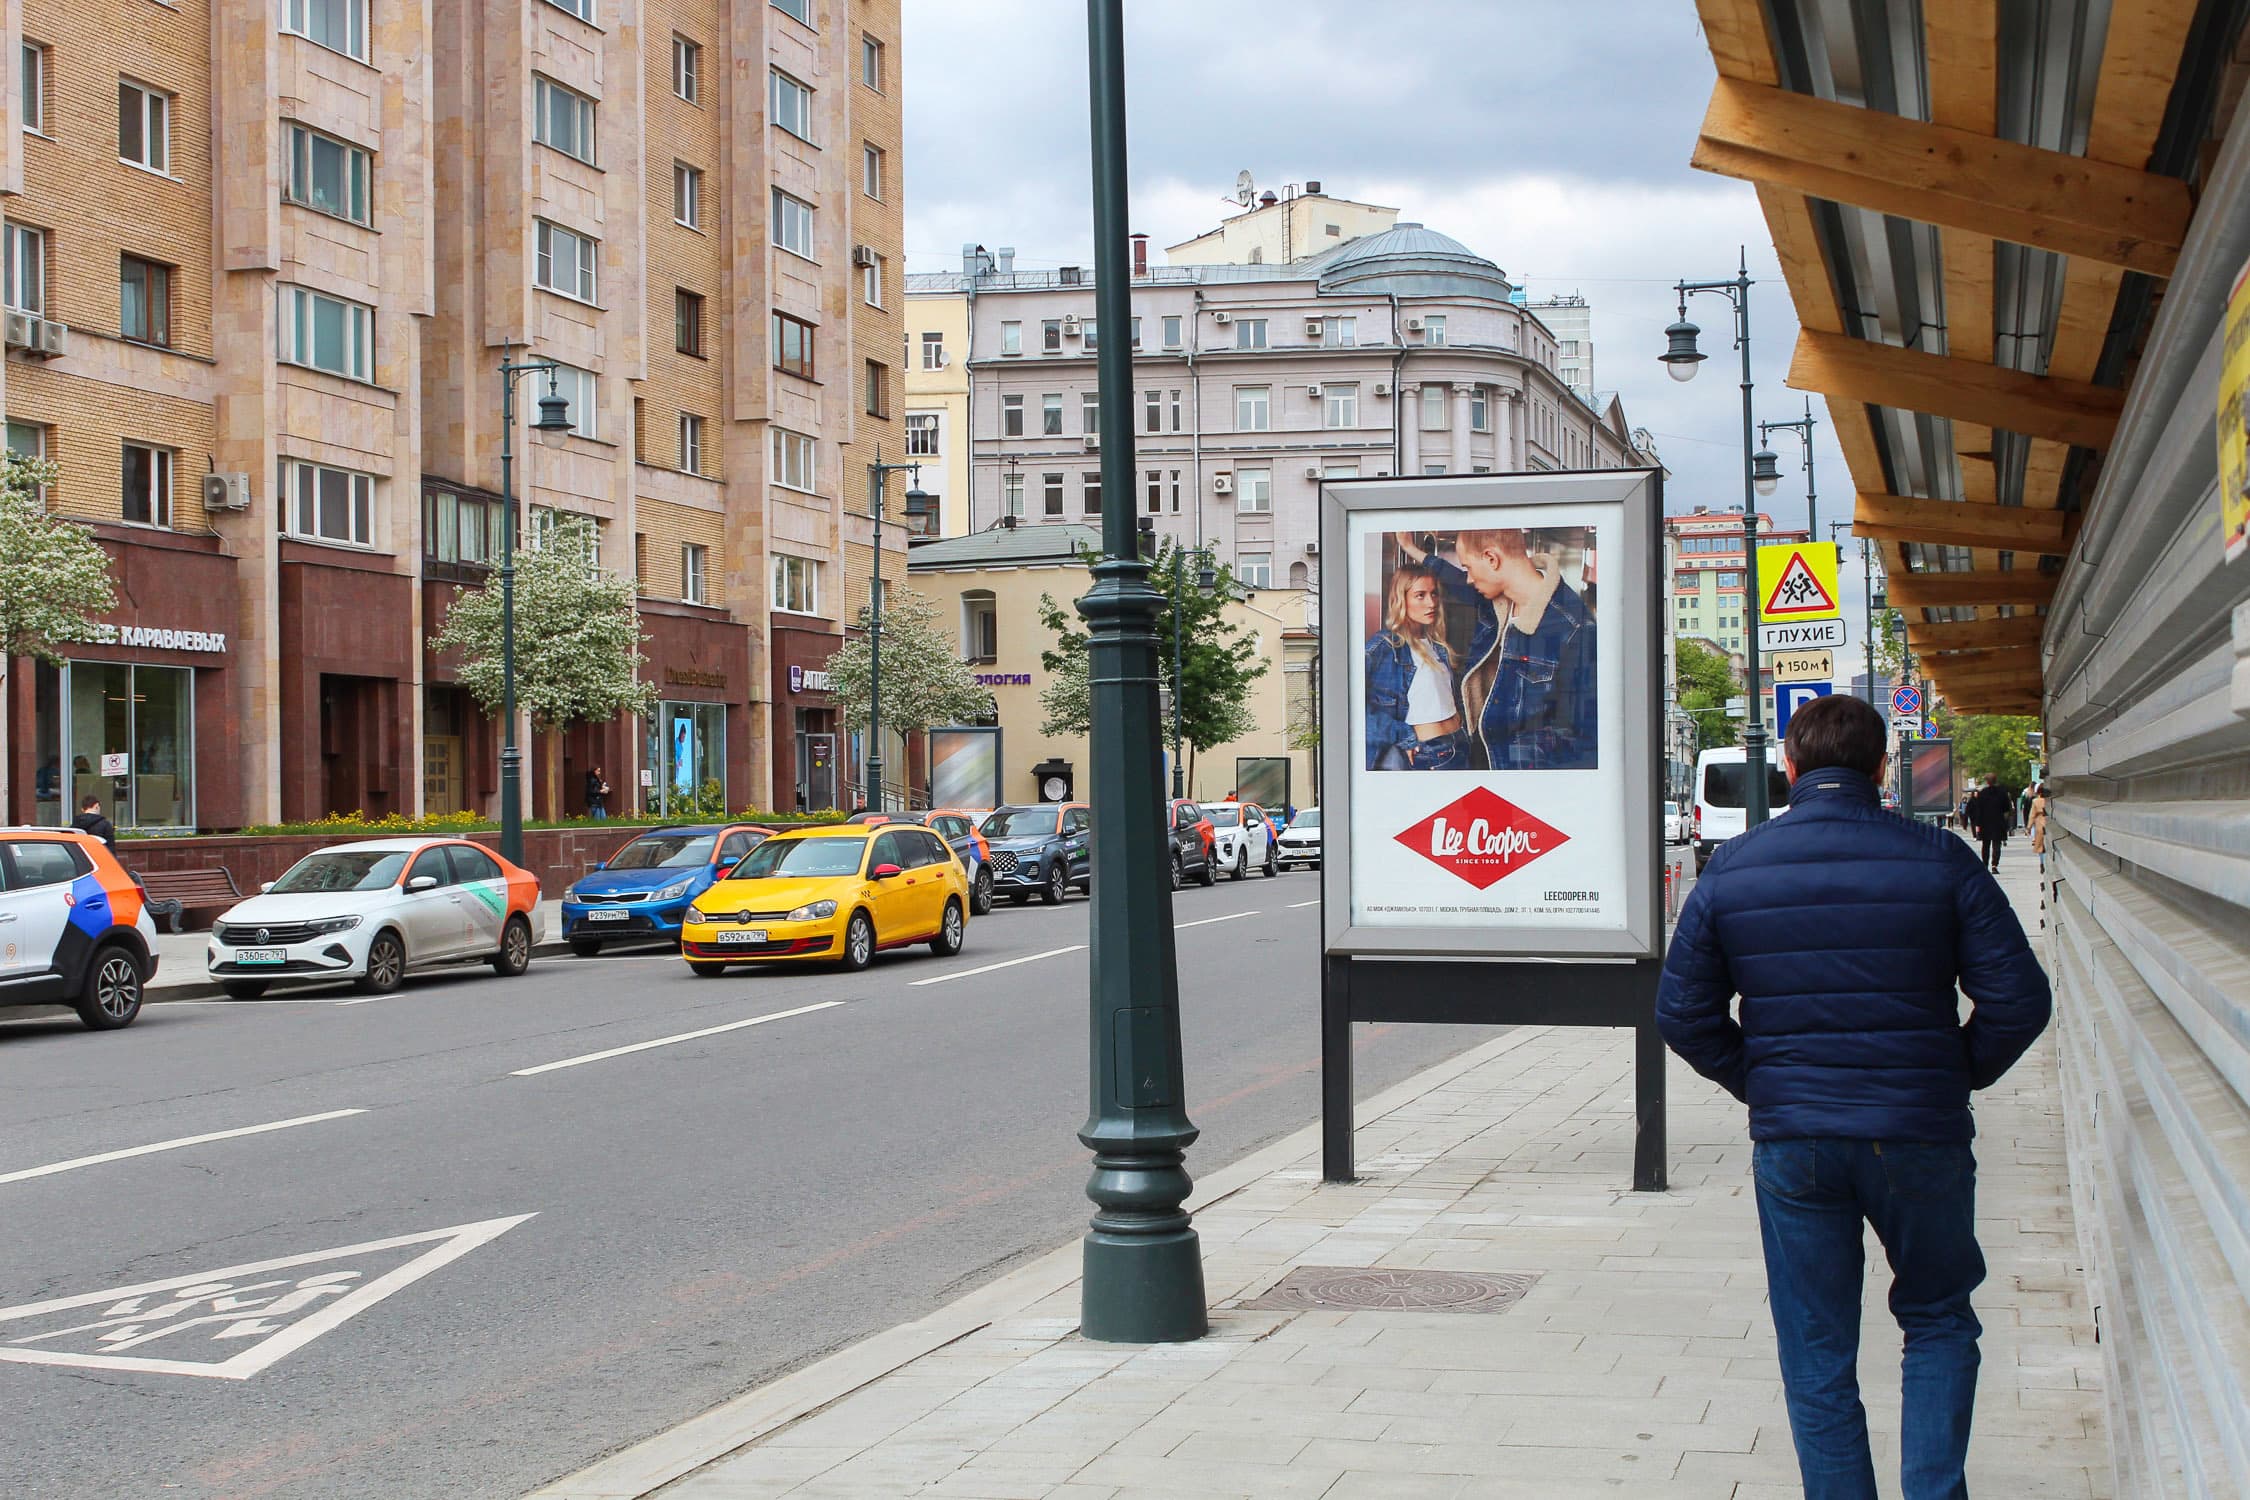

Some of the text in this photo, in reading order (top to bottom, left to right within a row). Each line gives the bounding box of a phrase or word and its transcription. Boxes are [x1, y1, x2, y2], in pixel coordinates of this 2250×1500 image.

[121, 626, 226, 652] КАРАВАЕВЫХ
[1767, 626, 1835, 644] ГЛУХИЕ
[974, 673, 1031, 686] ОЛОГИЯ
[1431, 817, 1541, 864] Lee Cooper
[1543, 891, 1600, 901] LEECOOPER.RU
